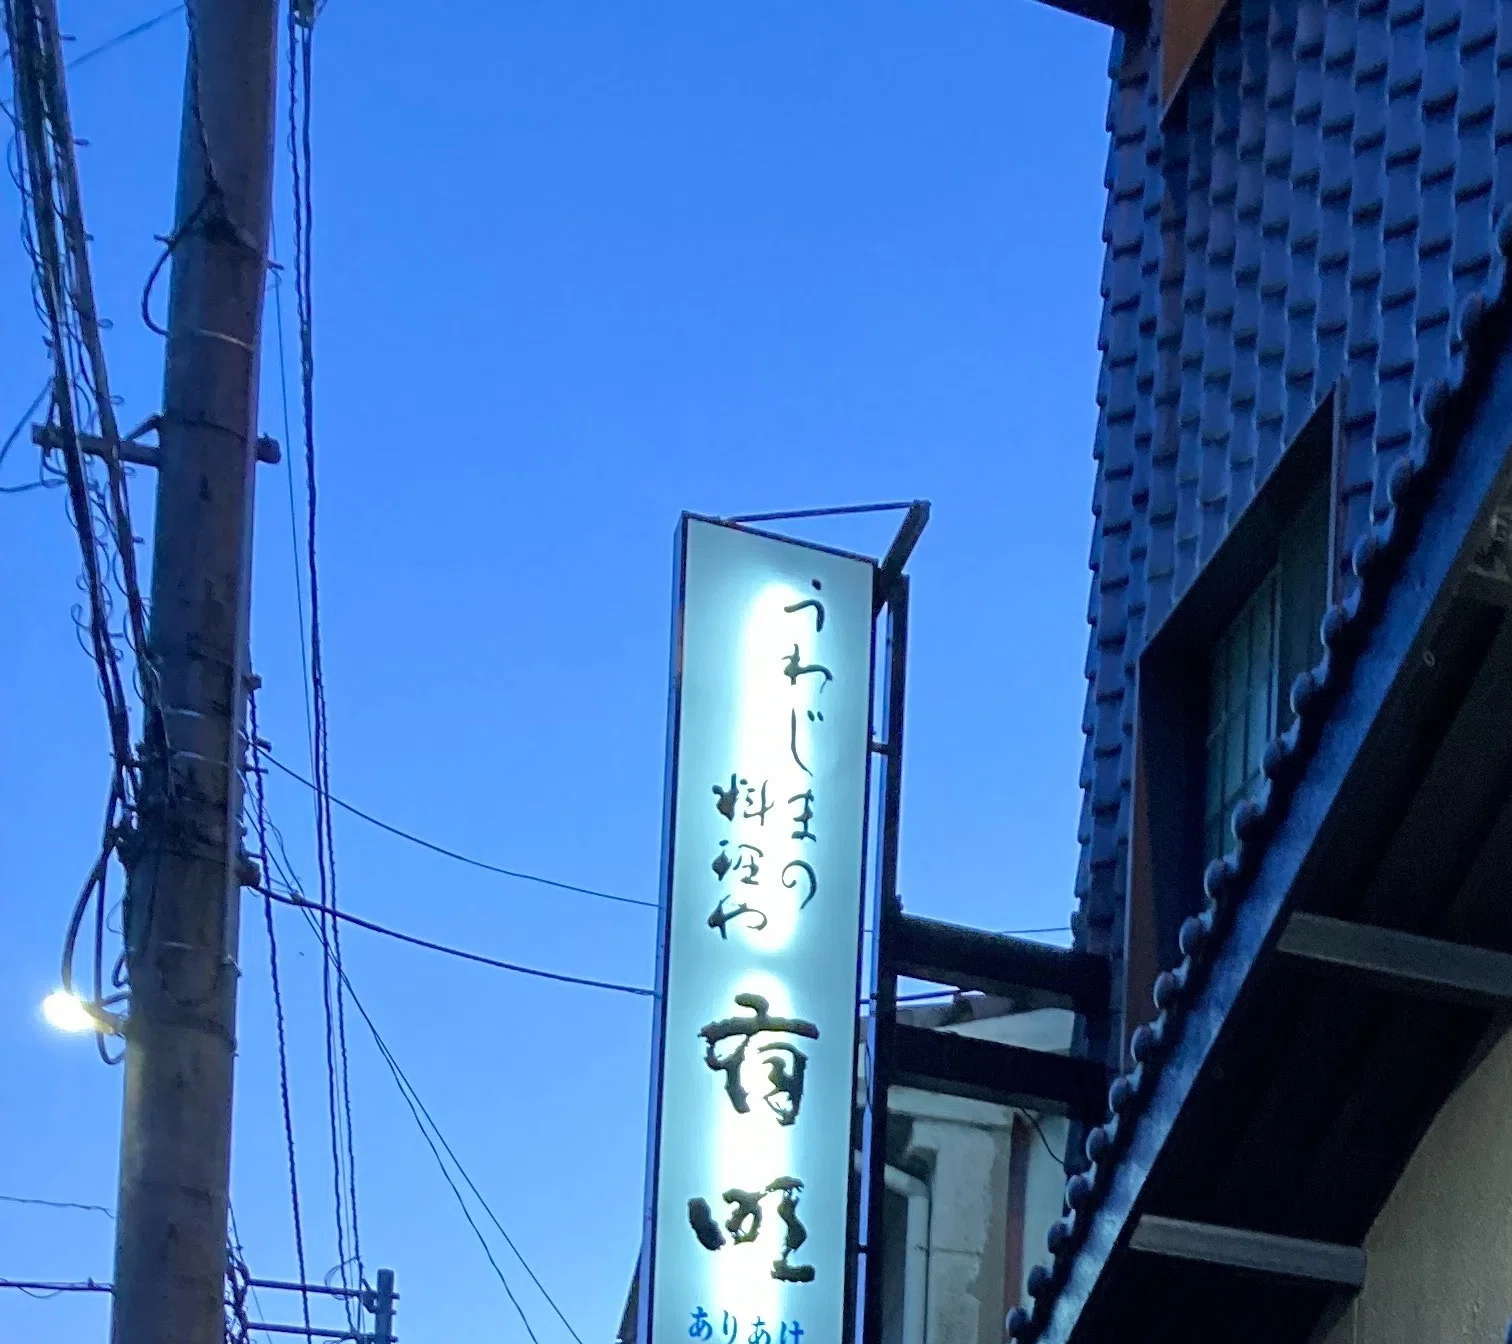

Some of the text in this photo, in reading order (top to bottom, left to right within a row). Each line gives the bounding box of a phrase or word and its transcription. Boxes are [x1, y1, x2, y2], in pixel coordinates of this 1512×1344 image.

[706, 776, 775, 941] 料理や
[780, 577, 836, 912] うわじまの
